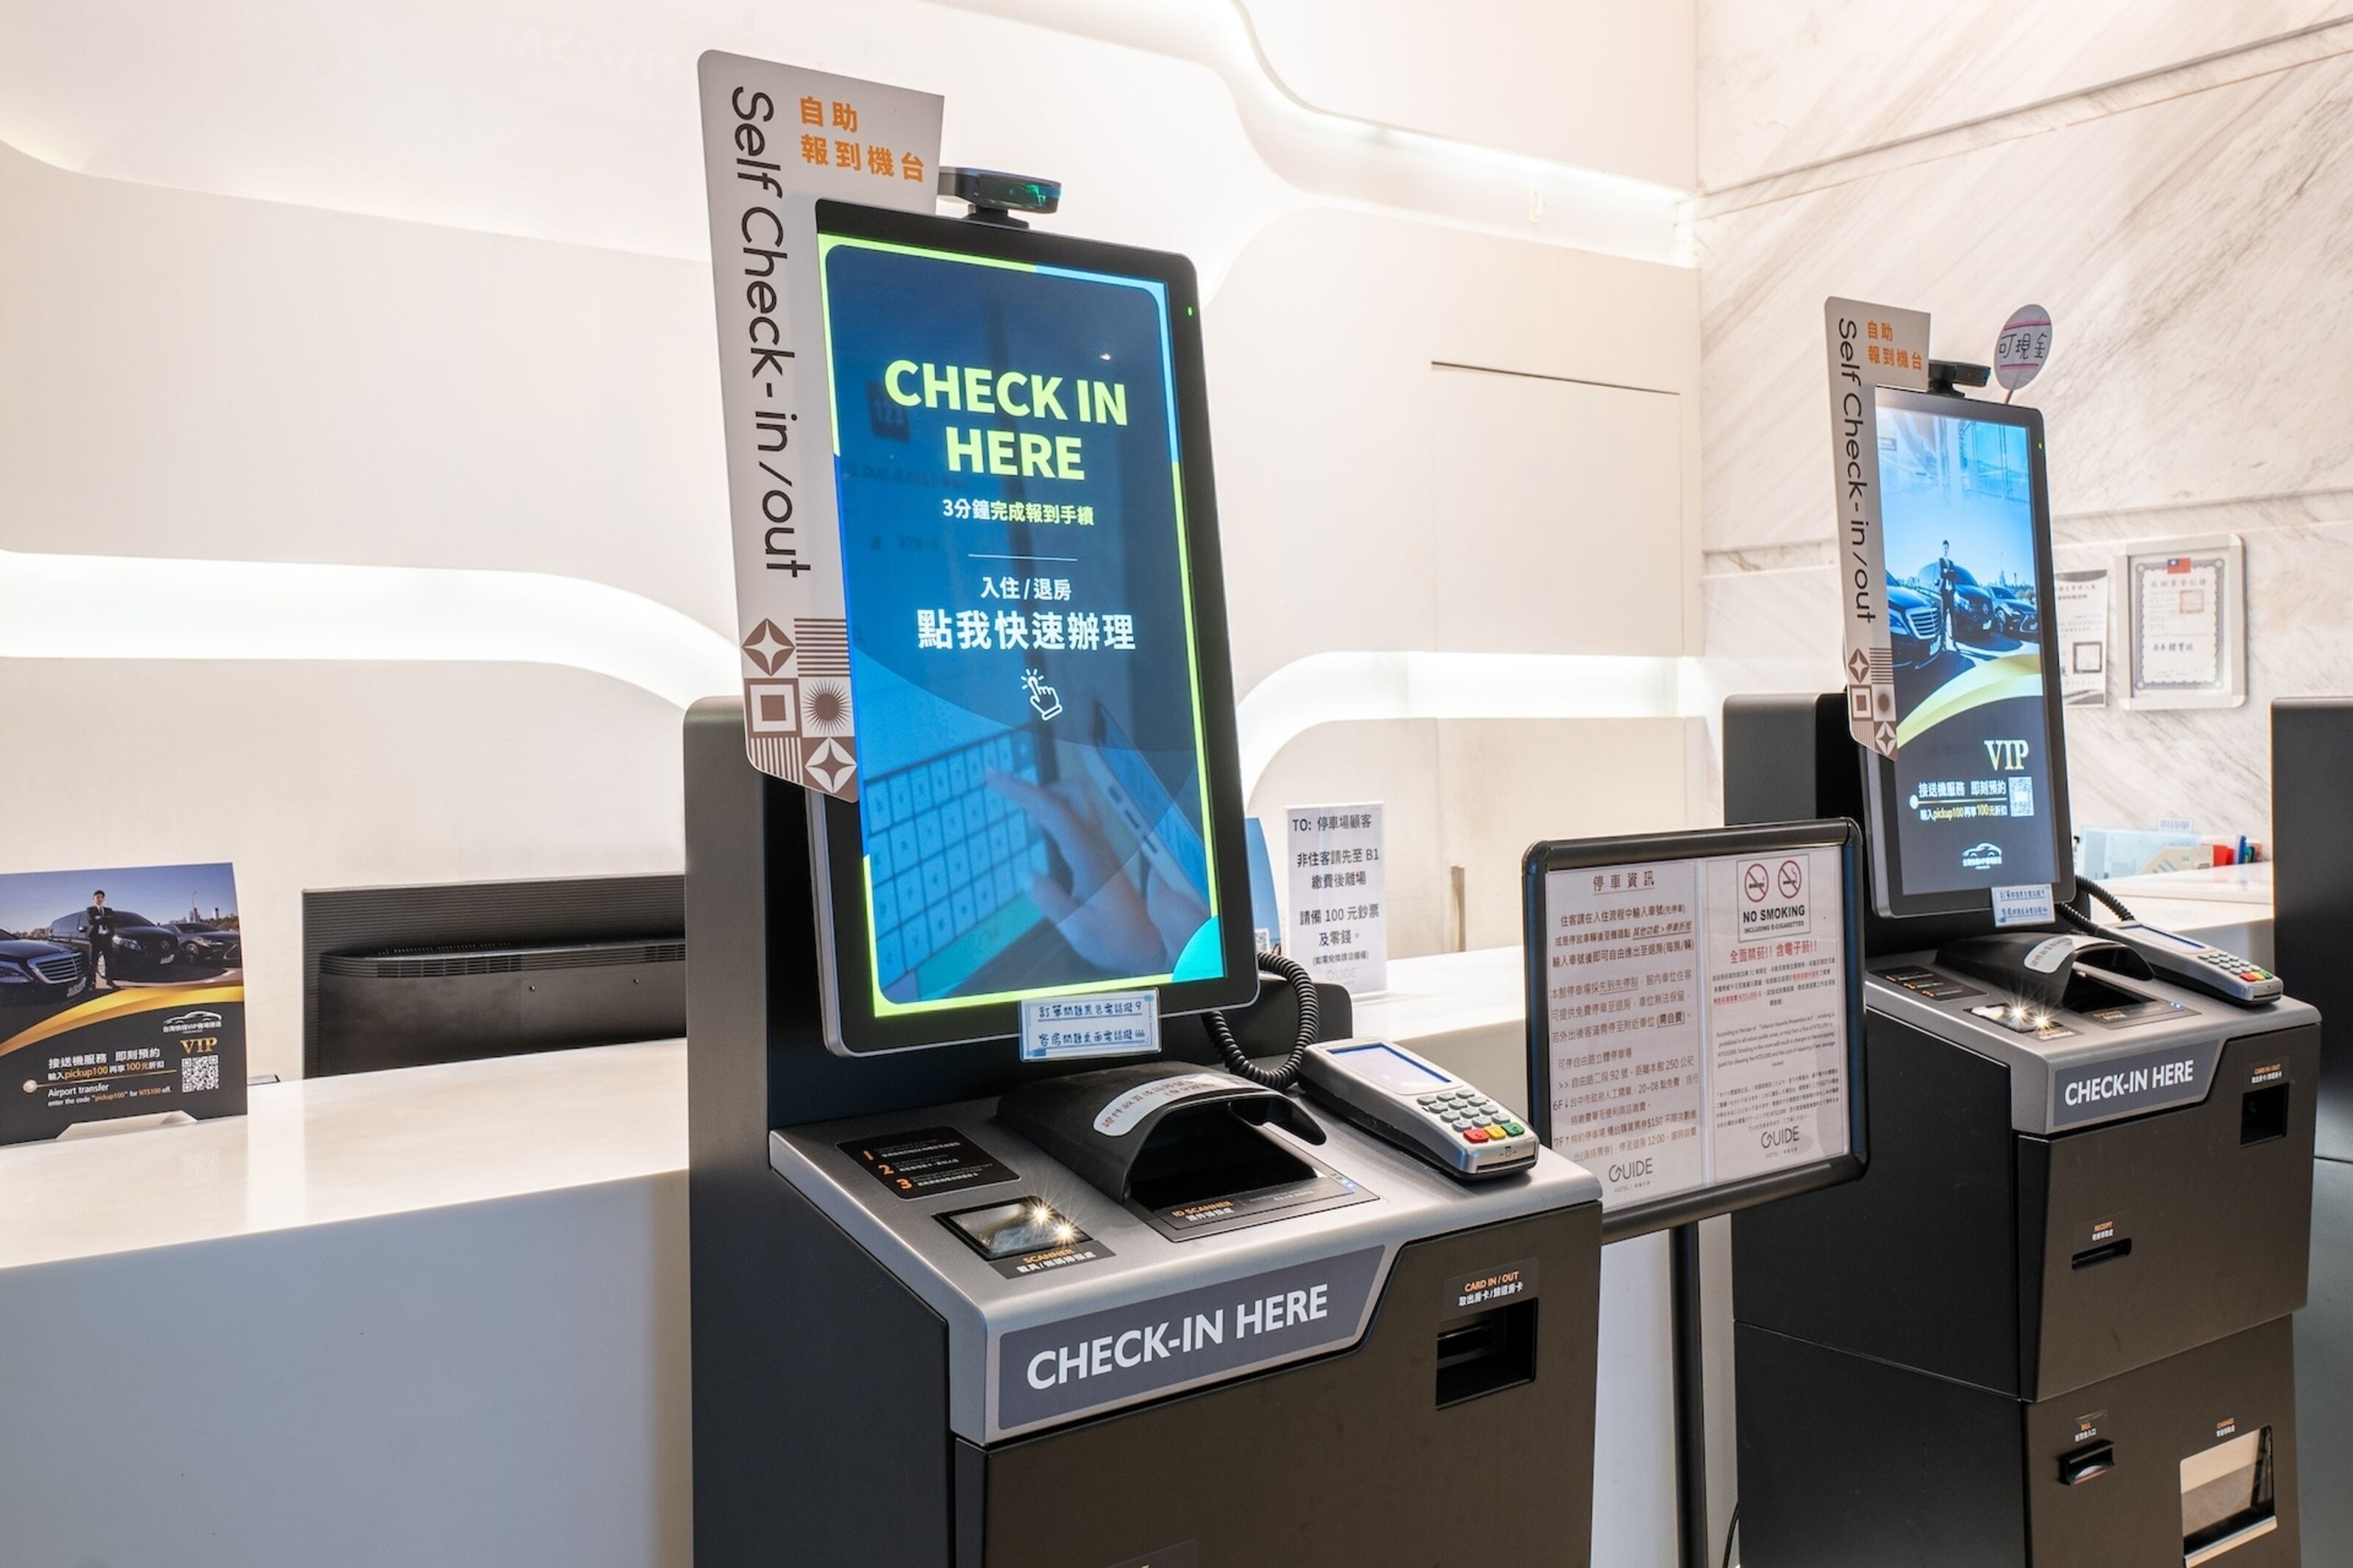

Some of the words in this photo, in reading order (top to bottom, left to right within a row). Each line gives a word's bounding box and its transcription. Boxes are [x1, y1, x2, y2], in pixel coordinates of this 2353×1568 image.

[799, 96, 859, 134] 自助
[732, 85, 785, 198] Self
[800, 133, 926, 183] 報到機台
[1867, 321, 1893, 342] 自助
[1838, 318, 1861, 387] Self
[1999, 331, 2048, 360] 可現金
[1868, 345, 1923, 372] 報到機台
[884, 359, 1068, 420] CHECK
[1075, 379, 1129, 426] IN
[945, 426, 1086, 482] HERE
[942, 498, 1095, 527] 3分鐘完成報到手續
[917, 609, 1137, 652] 點我快速辦理
[1984, 740, 2029, 771] VIP
[1918, 781, 1965, 798] 接送機服務
[1970, 780, 2007, 796] 即刻預約
[1292, 818, 1312, 831] TO:
[1317, 814, 1372, 831] 停車場顧客
[1297, 848, 1363, 867] 非住客請先至
[1365, 848, 1379, 861] B1
[1311, 871, 1366, 889] 繳費後離場
[1593, 870, 1654, 892] 停車資訊
[1299, 910, 1322, 926] 請備
[1325, 908, 1344, 923] 100
[1347, 903, 1379, 920] 元鈔票
[1743, 911, 1757, 923] NO
[1760, 905, 1805, 920] SMOKING
[1744, 924, 1770, 934] INCLUDING
[179, 1037, 218, 1054] VIP
[48, 1053, 107, 1070] 接送機服務
[115, 1047, 161, 1062] 即刻預約
[1610, 1070, 1620, 1080] 92
[1665, 1059, 1678, 1070] 250
[48, 1086, 76, 1098] Airport
[78, 1083, 110, 1095] transfer
[2064, 1068, 2148, 1106] CHECK-IN
[2152, 1059, 2194, 1089] HERE
[863, 1150, 874, 1161] 1
[878, 1164, 895, 1175] 2
[896, 1178, 913, 1189] 3
[1171, 1209, 1185, 1218] ID
[1185, 1200, 1234, 1215] SCANNER
[1023, 1249, 1075, 1264] SCANNER
[1464, 1279, 1488, 1292] CARD
[1488, 1275, 1498, 1286] IN
[1502, 1270, 1519, 1282] OUT
[1026, 1313, 1224, 1392] CHECK-IN
[1235, 1284, 1329, 1340] HERE
